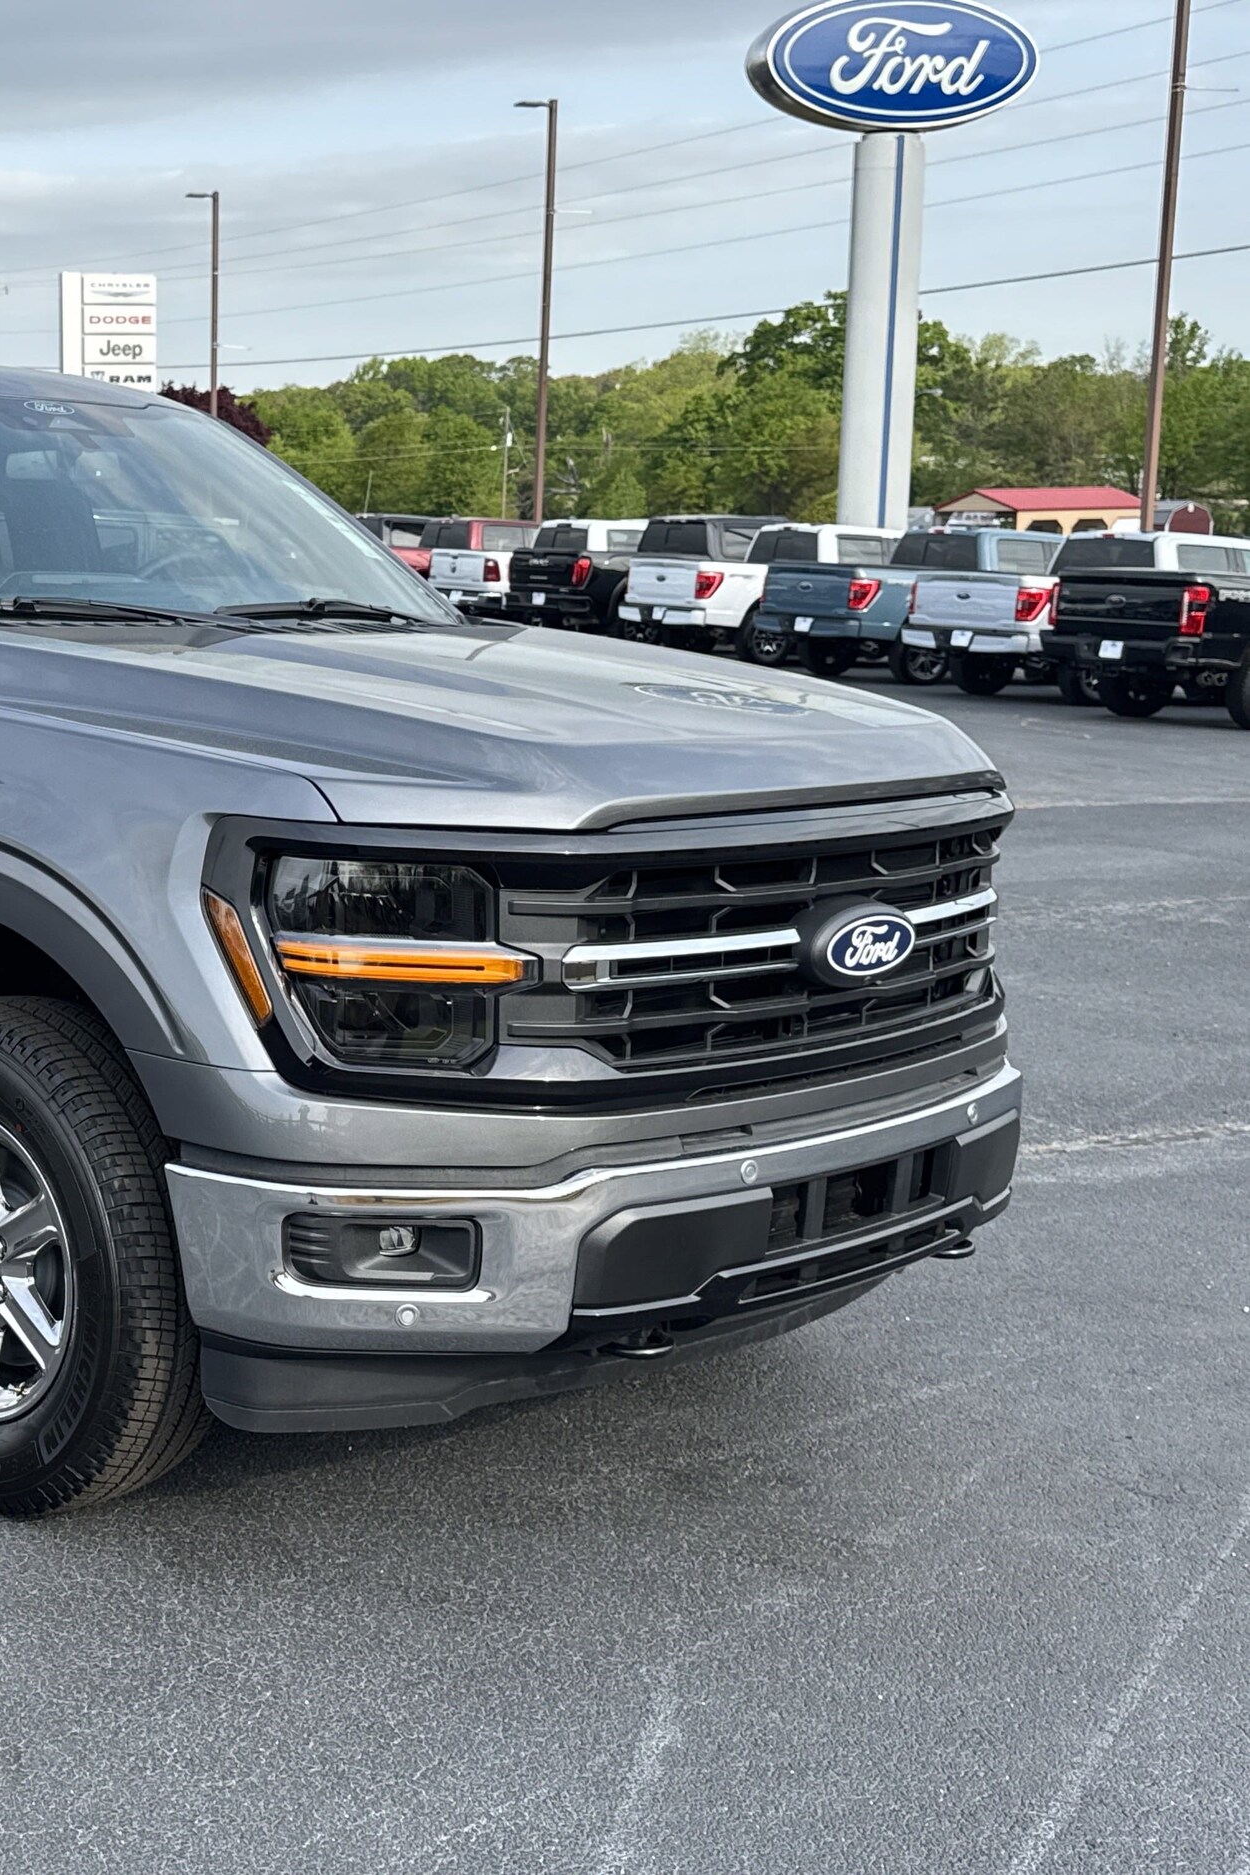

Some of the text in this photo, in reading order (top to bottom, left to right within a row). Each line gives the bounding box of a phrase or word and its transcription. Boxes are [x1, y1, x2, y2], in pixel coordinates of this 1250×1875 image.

[829, 17, 990, 96] Ford
[89, 316, 152, 324] DODGE
[99, 340, 143, 360] Jeep
[109, 375, 152, 383] RAM
[844, 924, 901, 968] Ford
